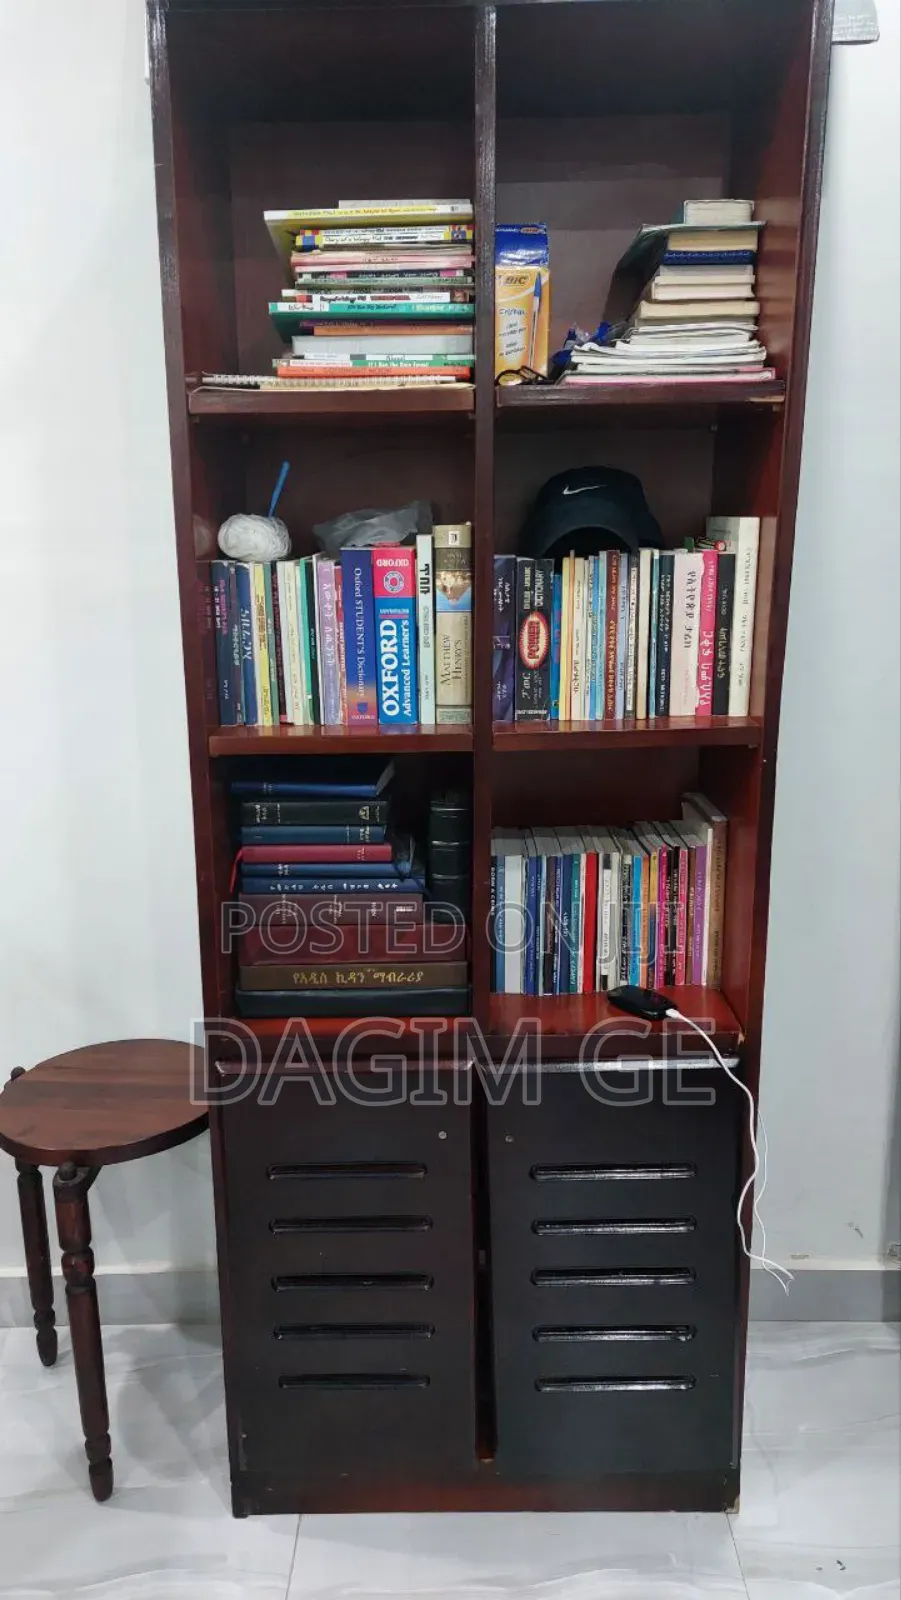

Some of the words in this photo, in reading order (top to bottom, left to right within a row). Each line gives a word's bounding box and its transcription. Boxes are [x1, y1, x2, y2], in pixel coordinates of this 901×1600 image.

[504, 276, 527, 285] BIC
[353, 567, 362, 597] Oxford
[376, 558, 410, 567] OXFORD
[535, 569, 544, 607] DICTIONARY
[354, 599, 365, 654] STUDENT'S
[401, 619, 410, 666] Learner's
[527, 619, 541, 660] POWER
[356, 657, 366, 697] Dictionary
[379, 619, 400, 716] OXFORD
[440, 634, 451, 686] MATTHEW
[452, 639, 462, 680] HENRY'S
[402, 669, 411, 716] Advanced
